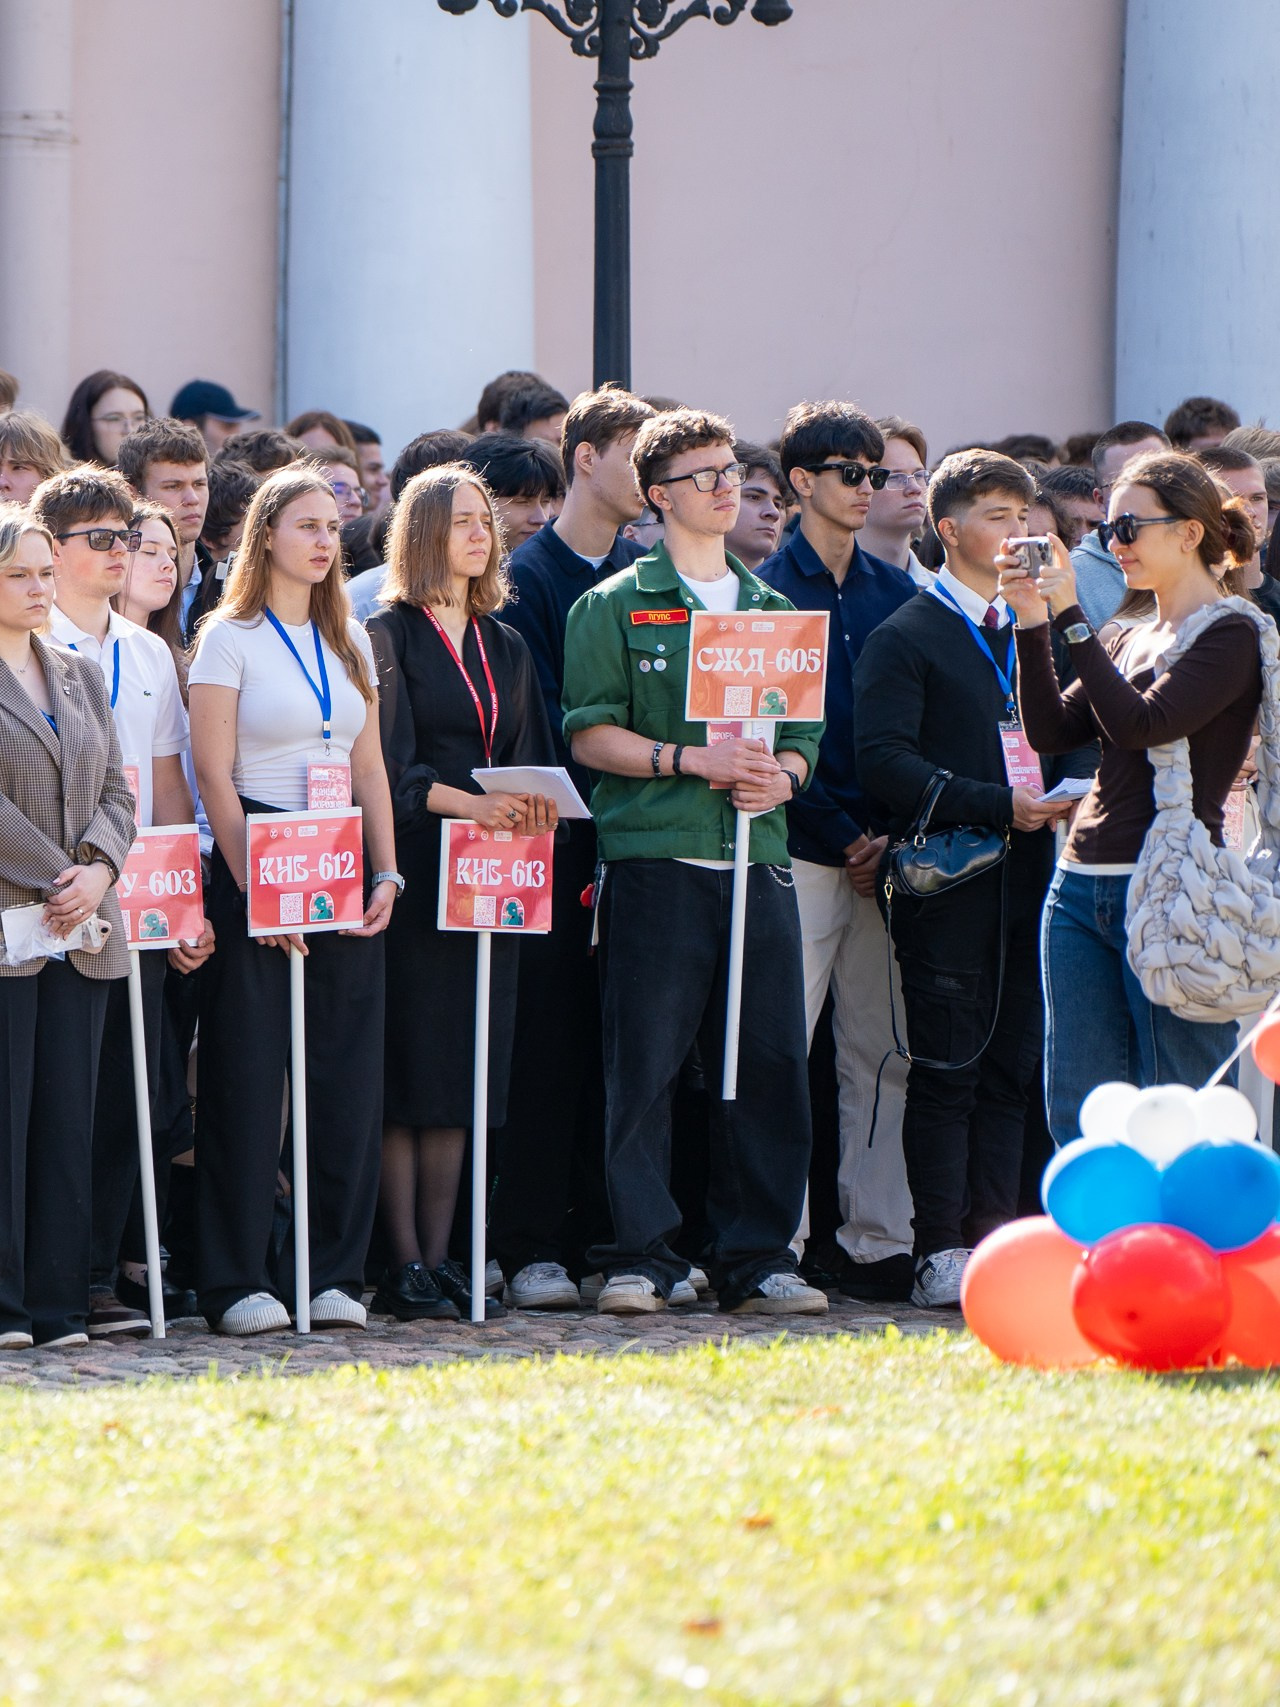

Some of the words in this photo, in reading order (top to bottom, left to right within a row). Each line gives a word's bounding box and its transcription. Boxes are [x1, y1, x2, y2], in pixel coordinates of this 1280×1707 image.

[648, 613, 671, 621] ПГУПС
[696, 647, 821, 678] СЖД-605
[116, 868, 197, 899] У-603
